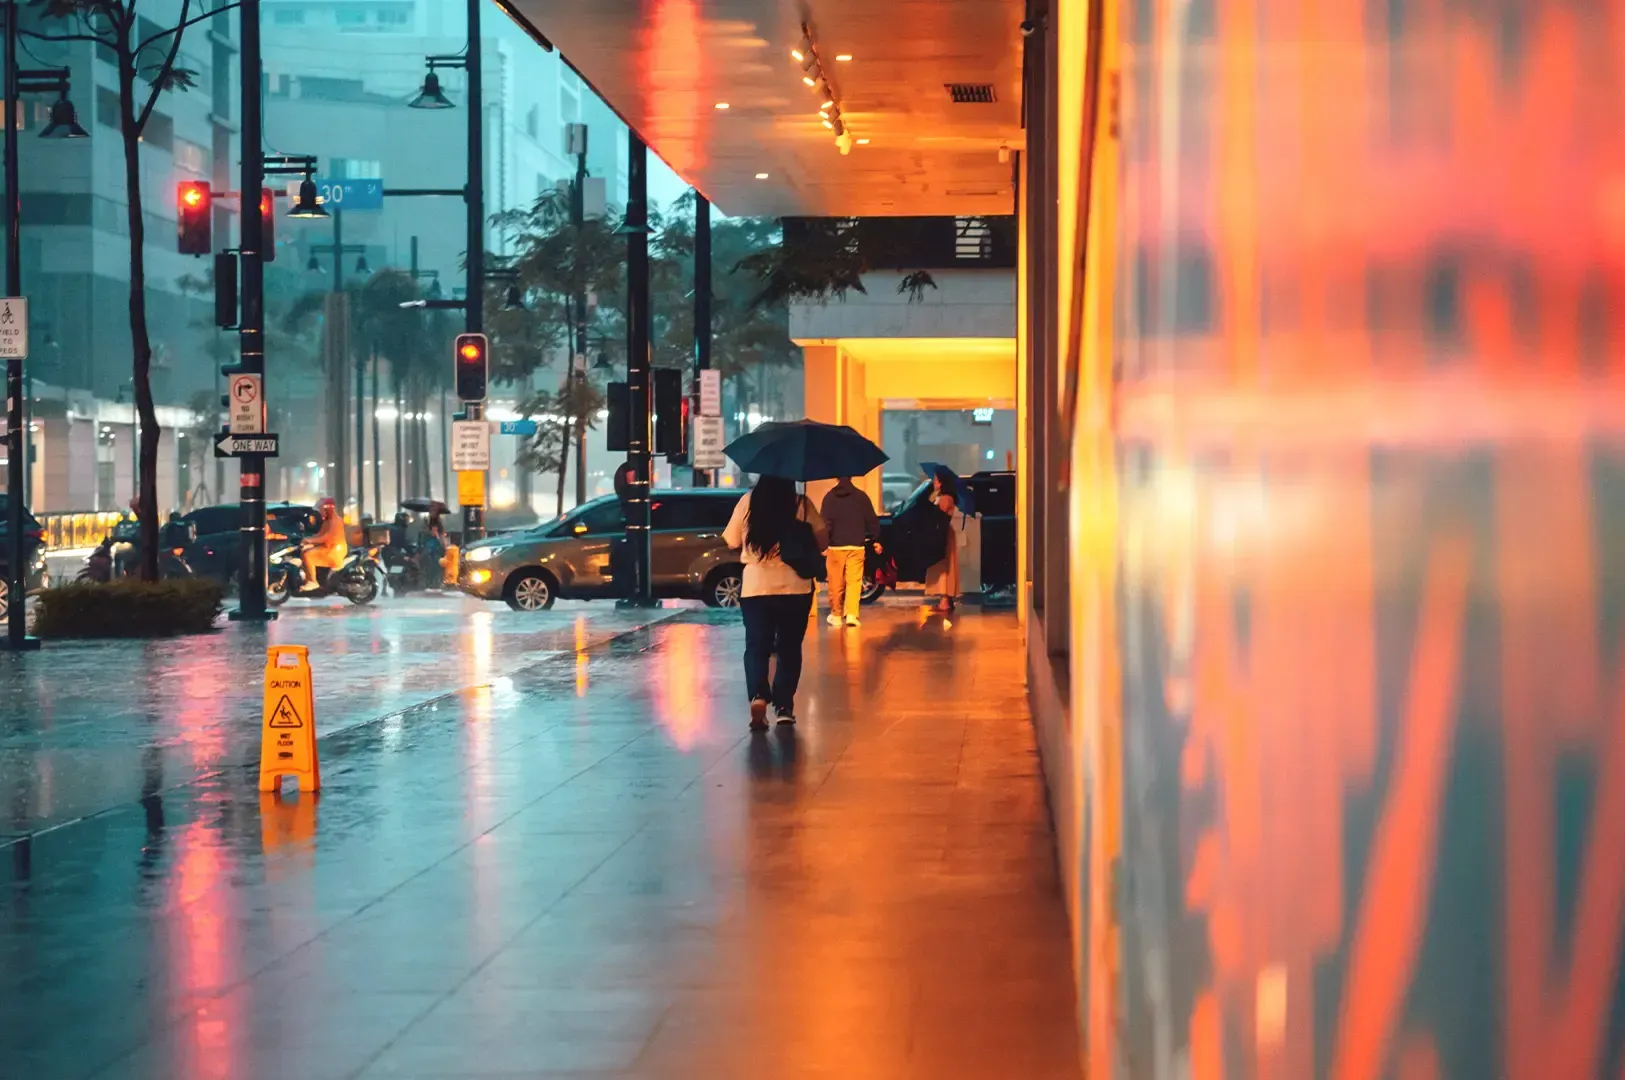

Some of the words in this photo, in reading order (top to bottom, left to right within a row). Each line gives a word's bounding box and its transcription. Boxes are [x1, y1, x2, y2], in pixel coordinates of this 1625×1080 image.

[233, 440, 252, 450] ONE
[255, 440, 274, 450] WAY
[270, 680, 301, 688] CAUTION
